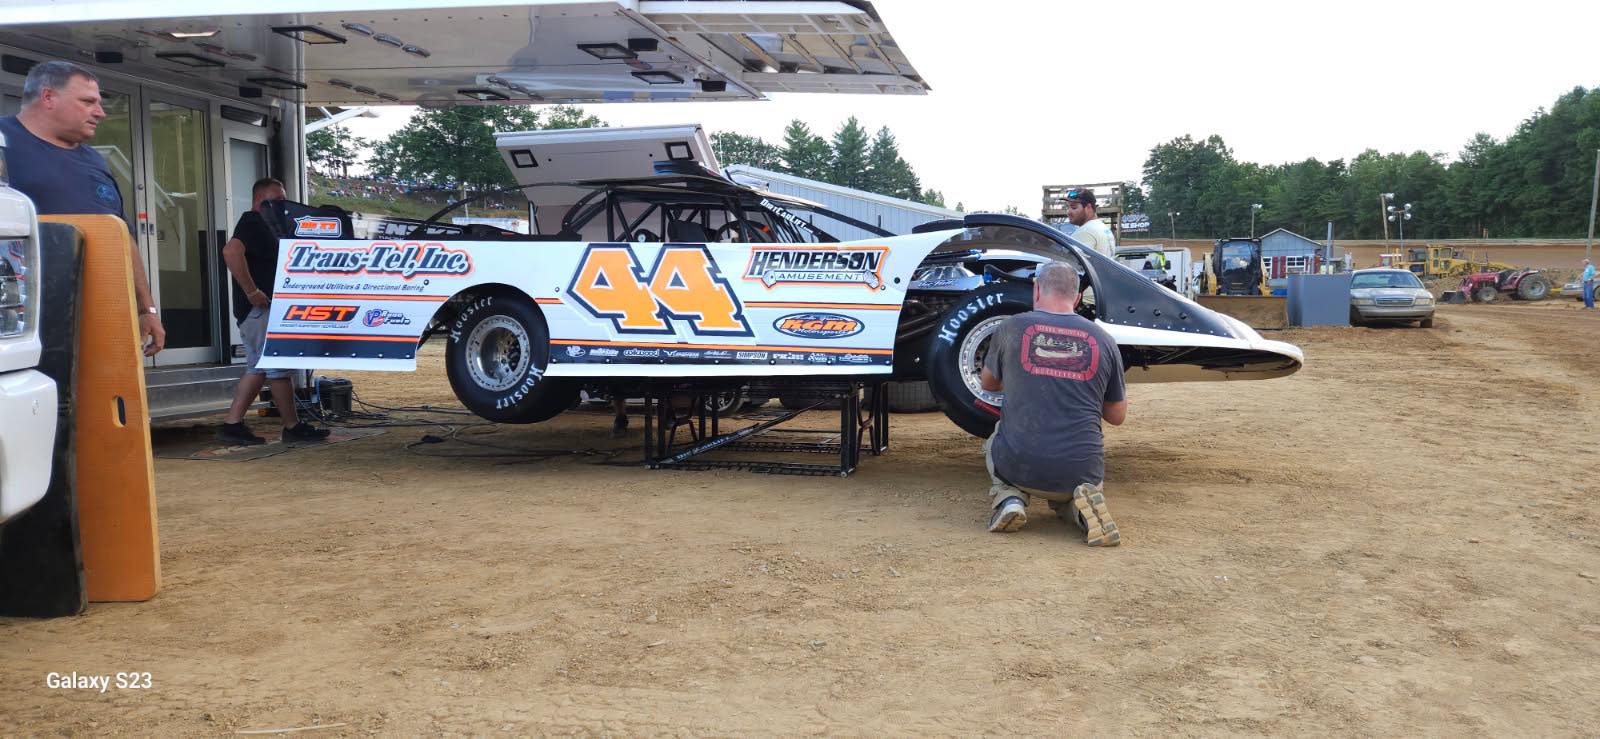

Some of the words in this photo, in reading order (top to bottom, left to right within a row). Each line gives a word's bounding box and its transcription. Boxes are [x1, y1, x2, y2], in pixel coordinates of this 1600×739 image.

[748, 251, 881, 276] HENDERSON
[282, 282, 324, 291] Underground
[325, 283, 354, 291] Utilities
[354, 283, 361, 291] &
[778, 272, 861, 281] AMUSEMENT
[567, 243, 755, 337] 44
[285, 305, 357, 321] HST
[450, 296, 493, 343] Hoosier
[938, 291, 1004, 348] Hoosier
[736, 351, 768, 360] SIMPSON
[495, 362, 545, 410] Hoosier
